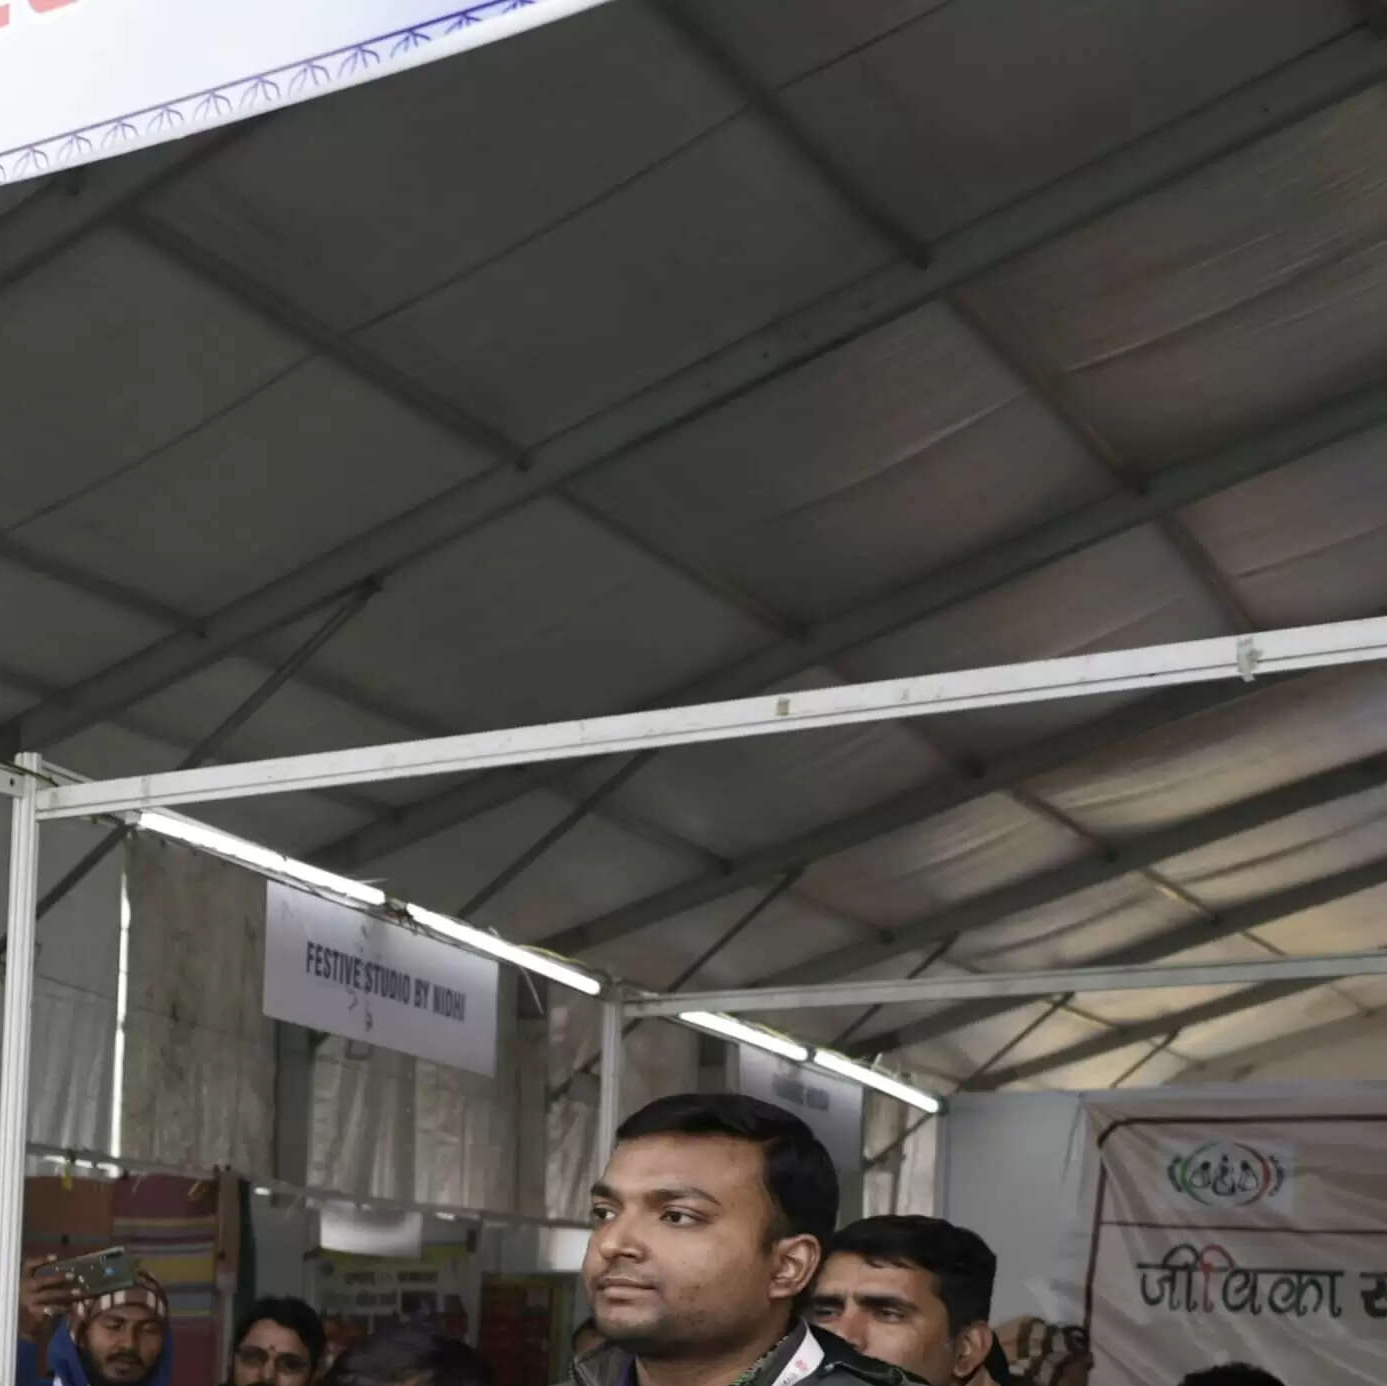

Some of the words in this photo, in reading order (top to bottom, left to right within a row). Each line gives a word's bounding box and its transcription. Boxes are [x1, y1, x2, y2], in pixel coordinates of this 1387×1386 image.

[305, 941, 363, 990] FESTIVE
[363, 961, 411, 1006] STUDIO
[413, 979, 431, 1009] BY
[1136, 1243, 1345, 1319] जीविका
